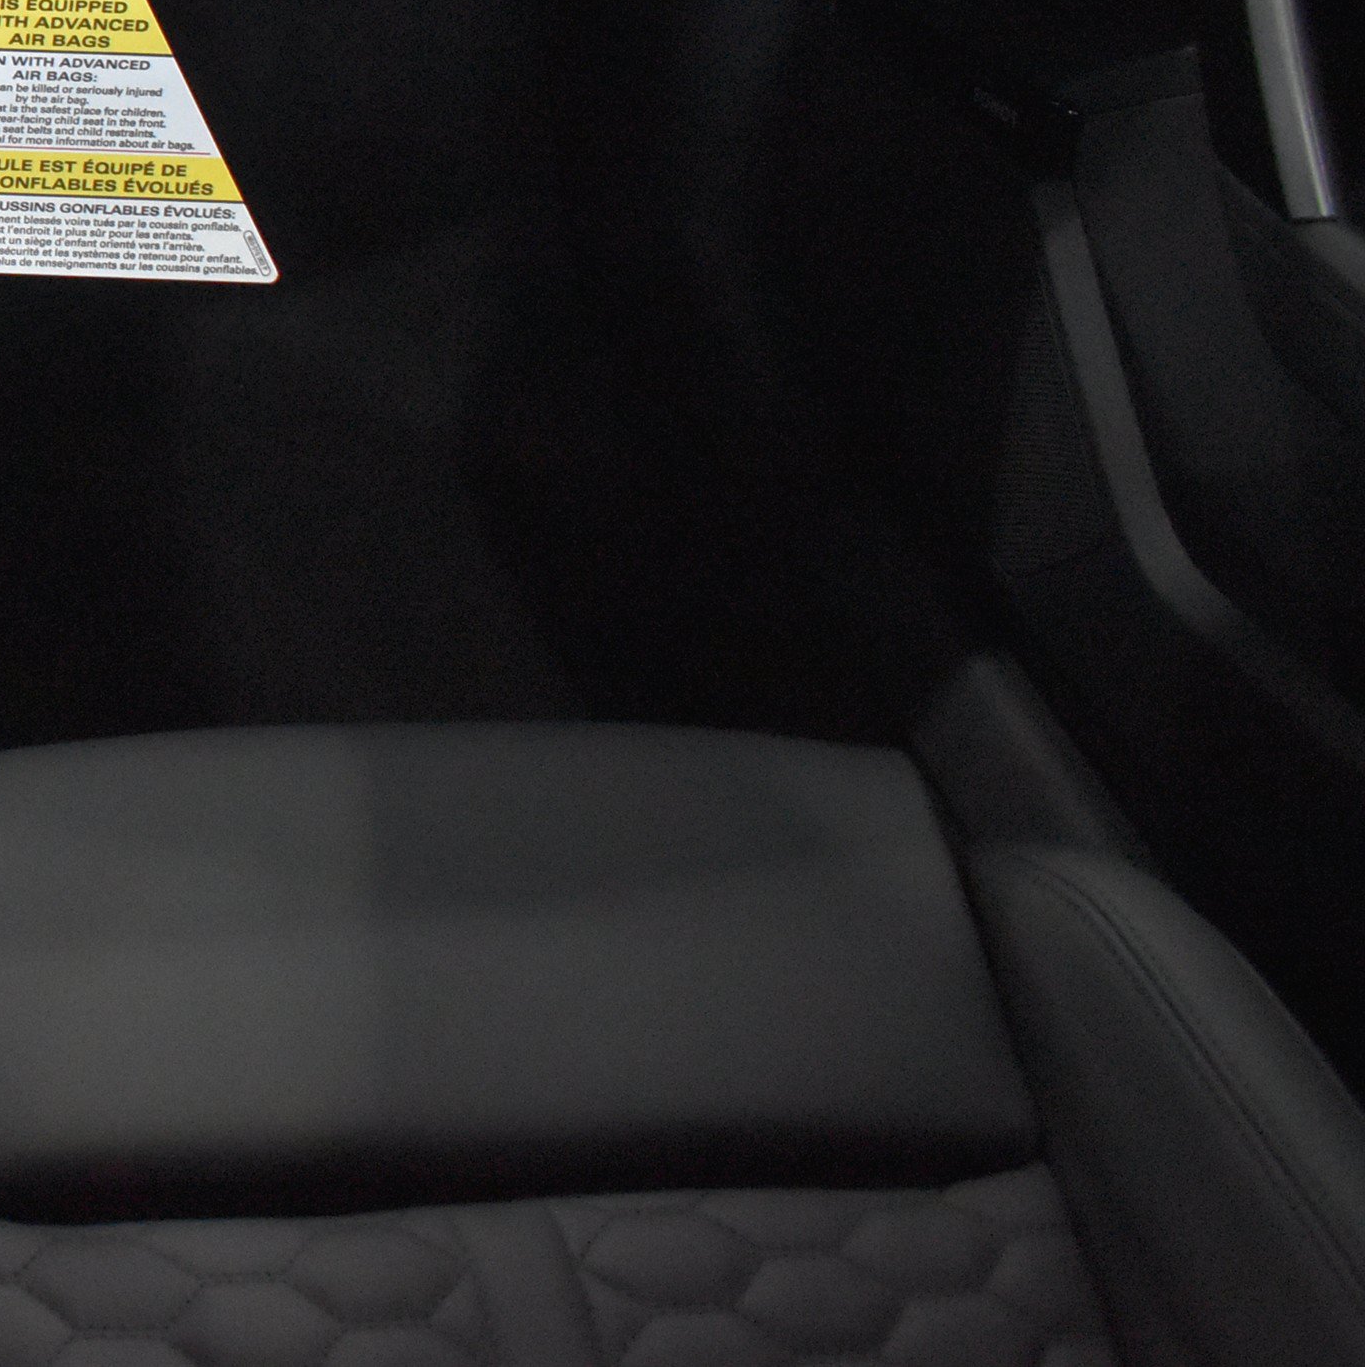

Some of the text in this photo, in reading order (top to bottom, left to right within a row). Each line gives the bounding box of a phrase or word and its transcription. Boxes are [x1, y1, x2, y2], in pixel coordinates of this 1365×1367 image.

[26, 0, 128, 14] EQUIPPED
[34, 17, 149, 32] ADVANCED
[9, 33, 110, 48] AIR BAGS
[12, 56, 54, 67] WITH
[59, 58, 151, 70] ADVANCED
[12, 71, 98, 82] AIR BAGS:
[16, 84, 29, 92] be
[32, 84, 59, 94] killed
[62, 86, 73, 94] or
[76, 86, 123, 97] seriously
[126, 87, 163, 98] injured
[15, 94, 89, 106] by the air bag.
[3, 125, 24, 134] seat
[27, 124, 52, 134] belts
[55, 127, 74, 135] and
[77, 128, 102, 136] child
[40, 160, 76, 173] EST
[83, 157, 155, 176] ÉQUIPÉ
[161, 164, 187, 177] DE
[124, 178, 214, 196] ÉVOLUÉS
[59, 203, 159, 217] GONFLABLES
[164, 205, 236, 219] ÉVOLUÉS:
